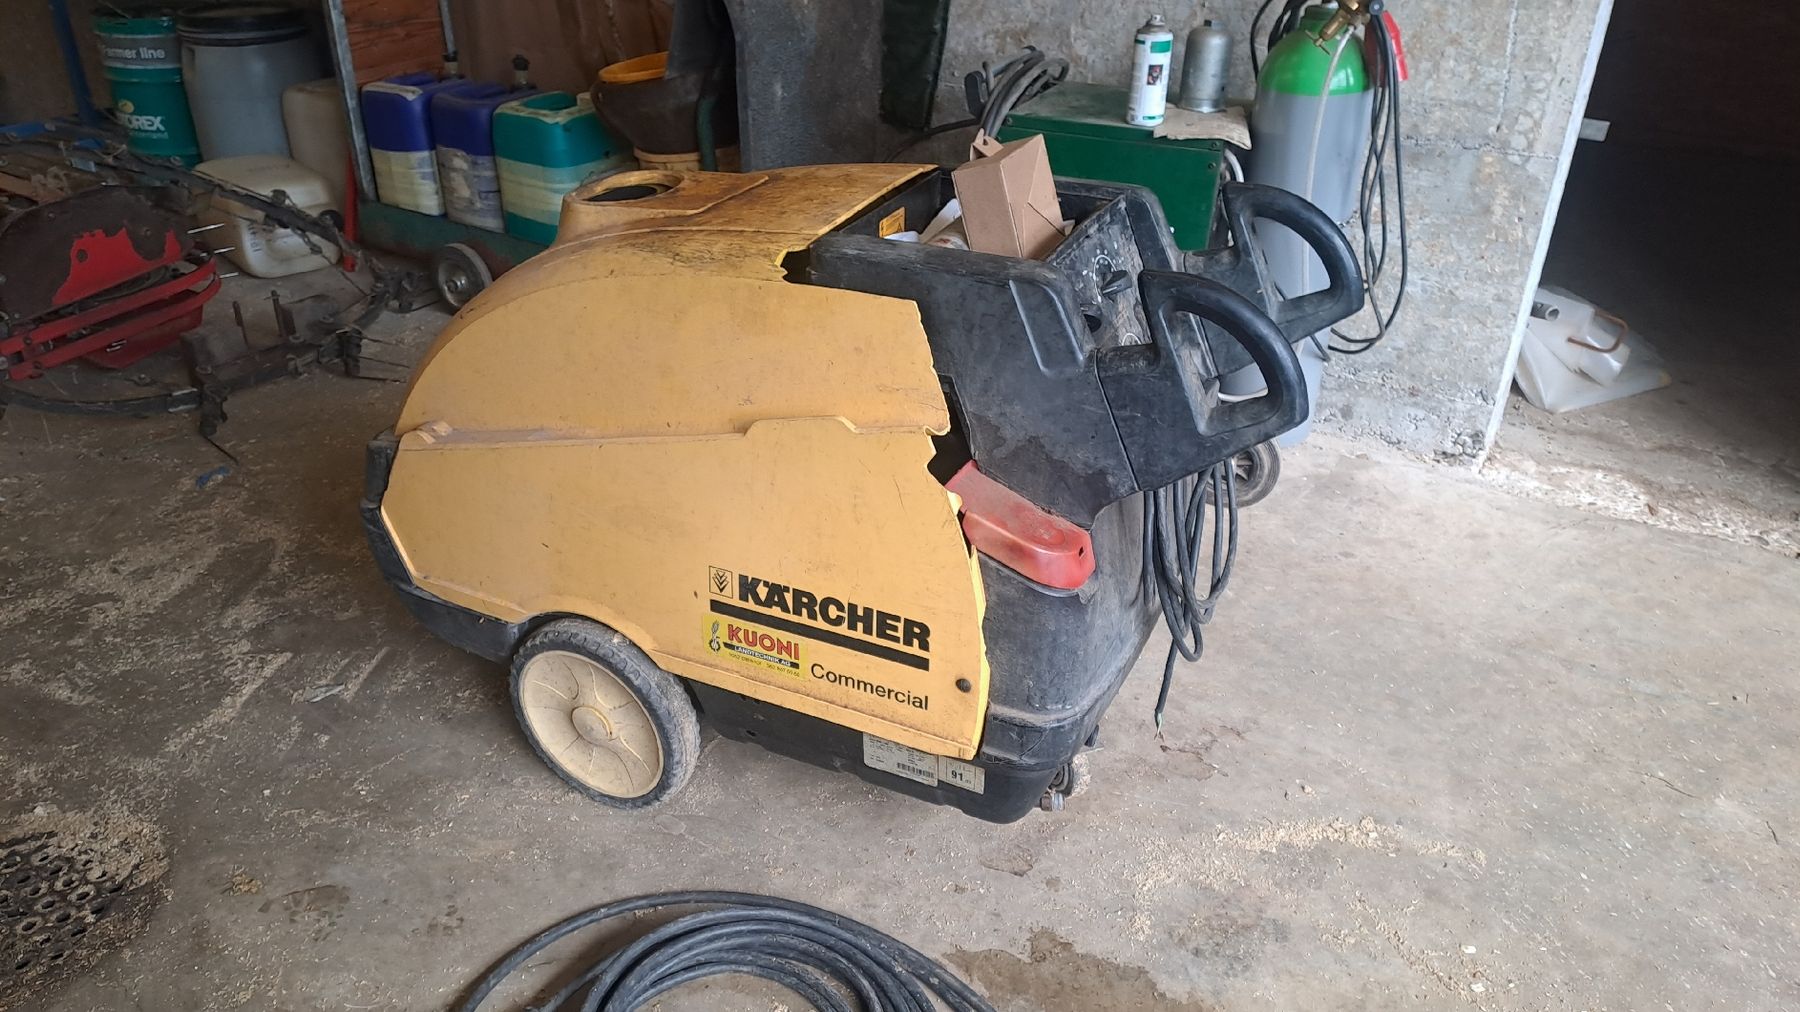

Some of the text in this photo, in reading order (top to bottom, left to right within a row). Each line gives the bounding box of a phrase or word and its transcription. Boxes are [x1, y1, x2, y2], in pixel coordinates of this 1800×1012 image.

[738, 573, 931, 653] KÄRCHER
[727, 623, 800, 661] KUONI
[734, 646, 780, 664] LANDTECHNIK
[811, 663, 929, 711] Commercial
[951, 769, 963, 782] 91
